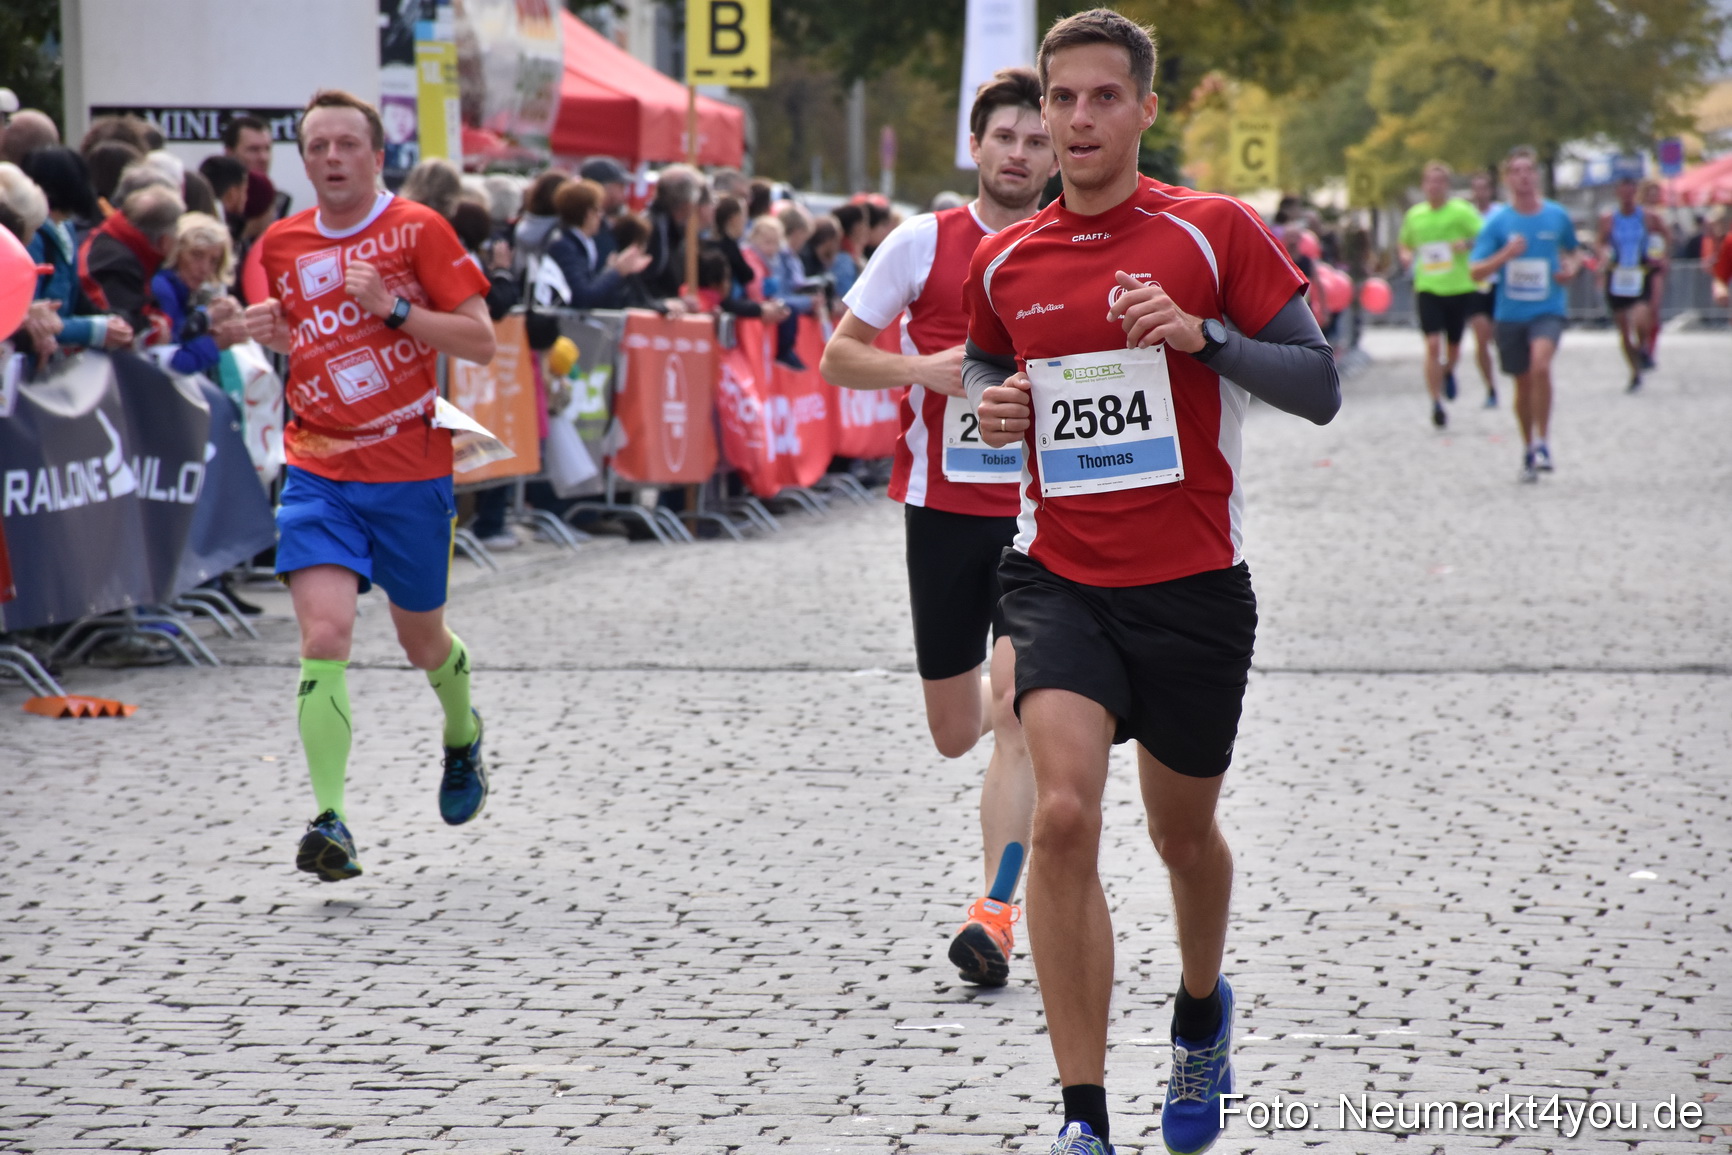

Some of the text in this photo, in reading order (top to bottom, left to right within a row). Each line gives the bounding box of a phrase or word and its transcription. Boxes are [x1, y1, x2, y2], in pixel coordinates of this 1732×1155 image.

[710, 1, 747, 55] B
[1241, 137, 1264, 171] C
[1071, 232, 1103, 242] CRAFT
[1075, 363, 1123, 379] BOCK
[960, 412, 981, 442] 2
[1051, 390, 1152, 441] 2584
[981, 453, 1016, 465] Tobias
[1077, 452, 1134, 470] Thomas
